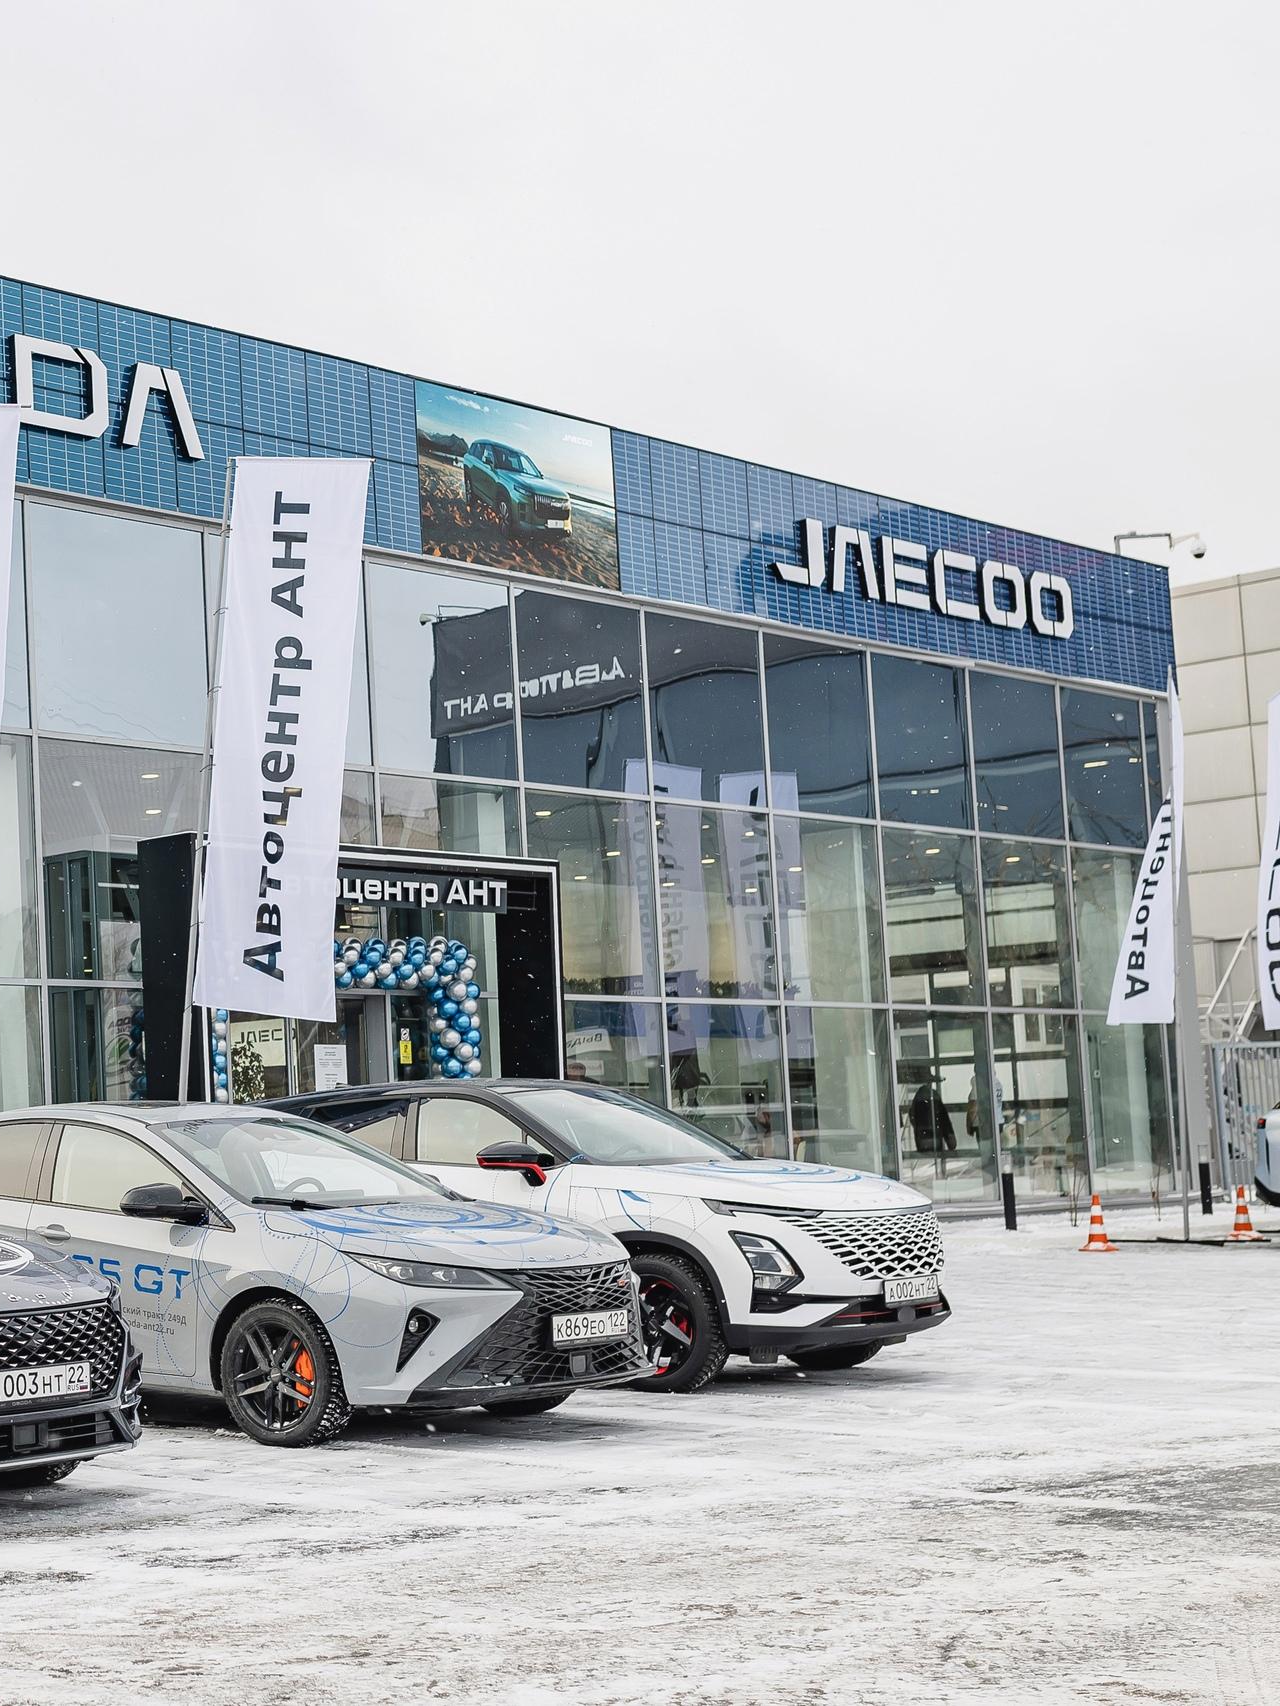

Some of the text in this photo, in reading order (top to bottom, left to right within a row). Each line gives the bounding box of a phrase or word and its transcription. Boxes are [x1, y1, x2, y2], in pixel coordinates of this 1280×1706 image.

[770, 517, 1075, 640] JAECOO
[242, 490, 313, 983] Автоцентр АНТ
[446, 878, 508, 907] АНТ
[234, 1028, 297, 1044] JAEC
[134, 1263, 192, 1299] GT
[926, 1278, 936, 1291] 22
[122, 1306, 141, 1315] ский
[607, 1312, 625, 1327] 122
[67, 1365, 85, 1384] 22
